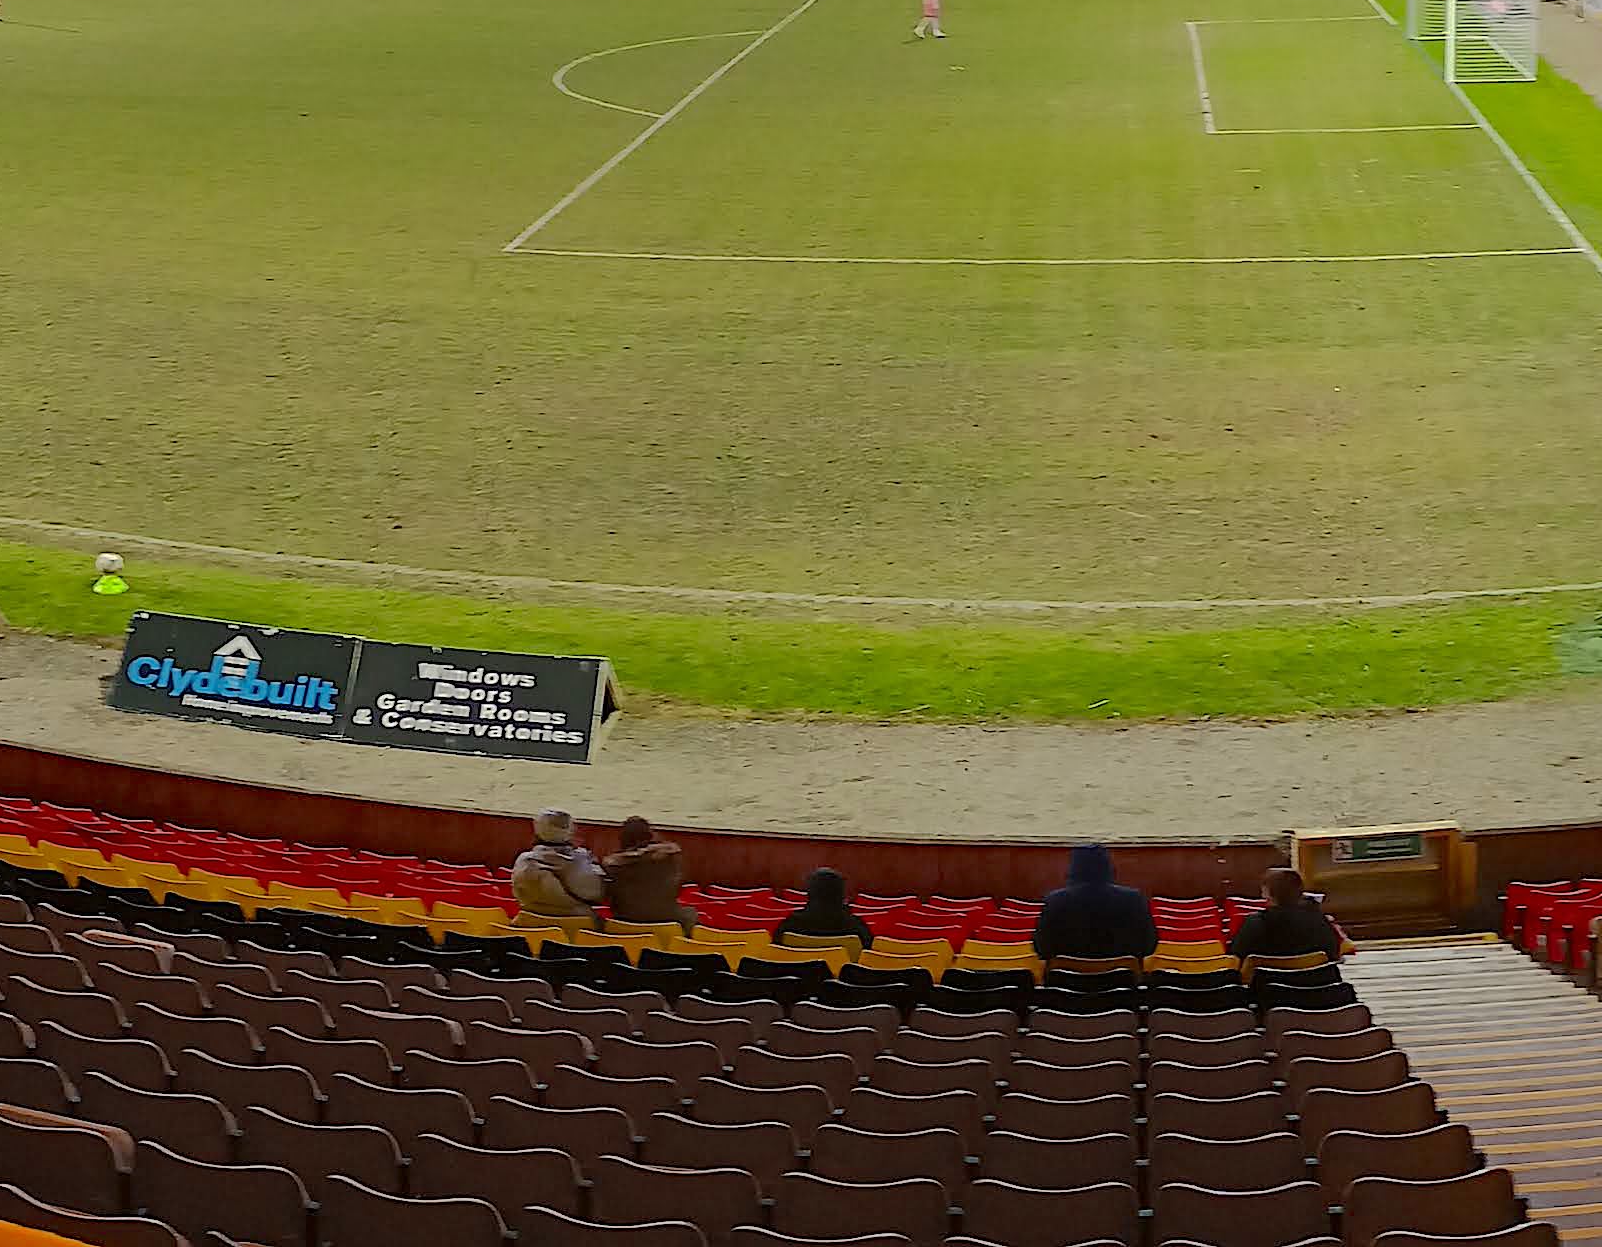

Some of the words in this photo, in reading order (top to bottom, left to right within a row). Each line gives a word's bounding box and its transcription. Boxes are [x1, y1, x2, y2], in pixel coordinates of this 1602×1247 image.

[126, 655, 339, 711] Clydebuilt
[417, 661, 536, 688] Windows
[433, 681, 513, 704] Doors
[376, 693, 471, 718] Garden
[479, 703, 567, 725] Rooms
[352, 708, 373, 726] &
[380, 712, 585, 745] Conservatories
